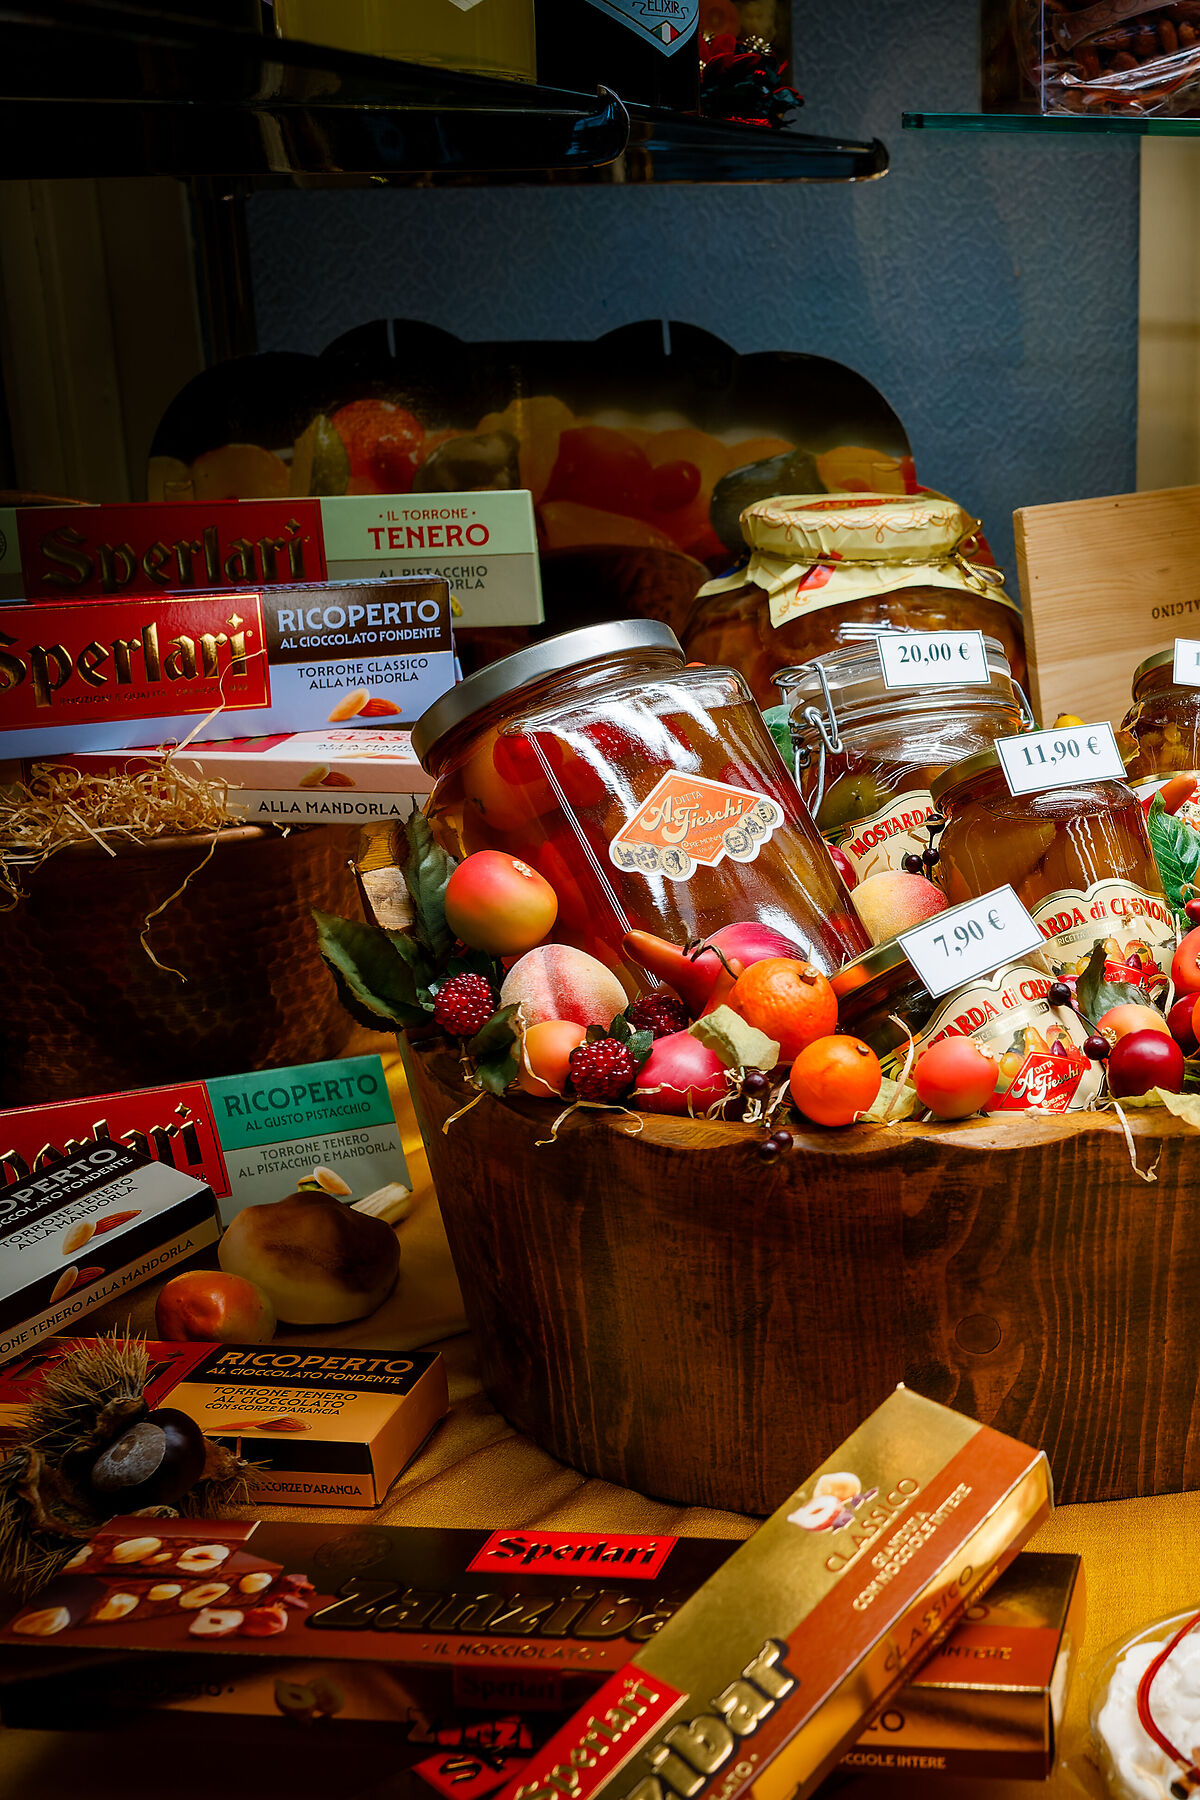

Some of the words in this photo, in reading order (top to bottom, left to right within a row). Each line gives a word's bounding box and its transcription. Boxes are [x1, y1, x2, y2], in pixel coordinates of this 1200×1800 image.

[647, 0, 680, 13] ELIXIR
[387, 510, 399, 521] IL
[402, 508, 469, 521] TORRONE
[368, 523, 490, 550] TENERO
[41, 518, 306, 594] Sperlari
[277, 599, 441, 633] RICOPERTO
[280, 637, 298, 650] AL
[299, 631, 378, 649] CIOCCOLATO
[379, 626, 442, 642] FONDENTE
[896, 642, 952, 666] 20,00
[958, 642, 971, 661] €
[297, 664, 364, 679] TORRONE
[367, 657, 429, 673] CLASSICO
[309, 678, 344, 690] ALLA
[346, 671, 419, 687] MANDORLA
[1021, 738, 1081, 766] 11,90
[1086, 736, 1101, 755] €
[258, 800, 302, 814] ALLA
[305, 802, 401, 815] MANDORLA
[674, 790, 704, 805] DITTA
[680, 834, 723, 851] CREMONA
[848, 805, 937, 860] MOSTARDA
[933, 918, 985, 958] 7,90
[987, 908, 1006, 931] €
[1037, 907, 1089, 941] ARDA
[1089, 900, 1107, 919] di
[1001, 985, 1021, 1010] di
[1035, 1060, 1055, 1074] DITTA
[223, 1074, 378, 1118] RICOPERTO
[245, 1119, 263, 1132] AL
[264, 1112, 304, 1128] GUSTO
[306, 1101, 371, 1121] PISTACCHIO
[238, 1166, 255, 1179] AL
[257, 1154, 321, 1175] PISTACCHIO
[324, 1151, 331, 1162] E
[332, 1141, 397, 1161] MANDORLA
[260, 1141, 321, 1161] TORRONE
[323, 1132, 370, 1150] TENERO
[0, 1149, 117, 1215] OPERTO
[62, 1156, 134, 1193] FONDENTE
[0, 1207, 75, 1248] TORRONE
[74, 1177, 134, 1208] TENERO
[18, 1228, 57, 1251] ALLA
[55, 1186, 138, 1230] MANDORLA
[30, 1301, 83, 1338] TENERO
[85, 1281, 121, 1307] ALLA
[121, 1239, 195, 1286] MANDORLA
[206, 1367, 227, 1375] AL
[229, 1368, 323, 1380] CIOCCOLATO
[323, 1372, 404, 1385] FONDENTE
[216, 1351, 414, 1374] RICOPERTO
[212, 1386, 292, 1398] TORRONE
[293, 1389, 358, 1402] TENERO
[213, 1395, 236, 1403] AL
[240, 1395, 345, 1409] CIOCCOLATO
[204, 1402, 230, 1410] CON
[231, 1402, 279, 1413] SCORZE
[278, 1405, 341, 1416] D'ARANCIA
[303, 1483, 362, 1496] D'ARANCIA
[825, 1477, 921, 1575] CLASSICO
[487, 1536, 658, 1568] Sperlari
[303, 1576, 674, 1642] Zanziba
[884, 1564, 974, 1673] CLASSICO
[433, 1642, 449, 1655] IL
[456, 1643, 596, 1661] NOCCIOLATO
[896, 1754, 948, 1770] INTERE
